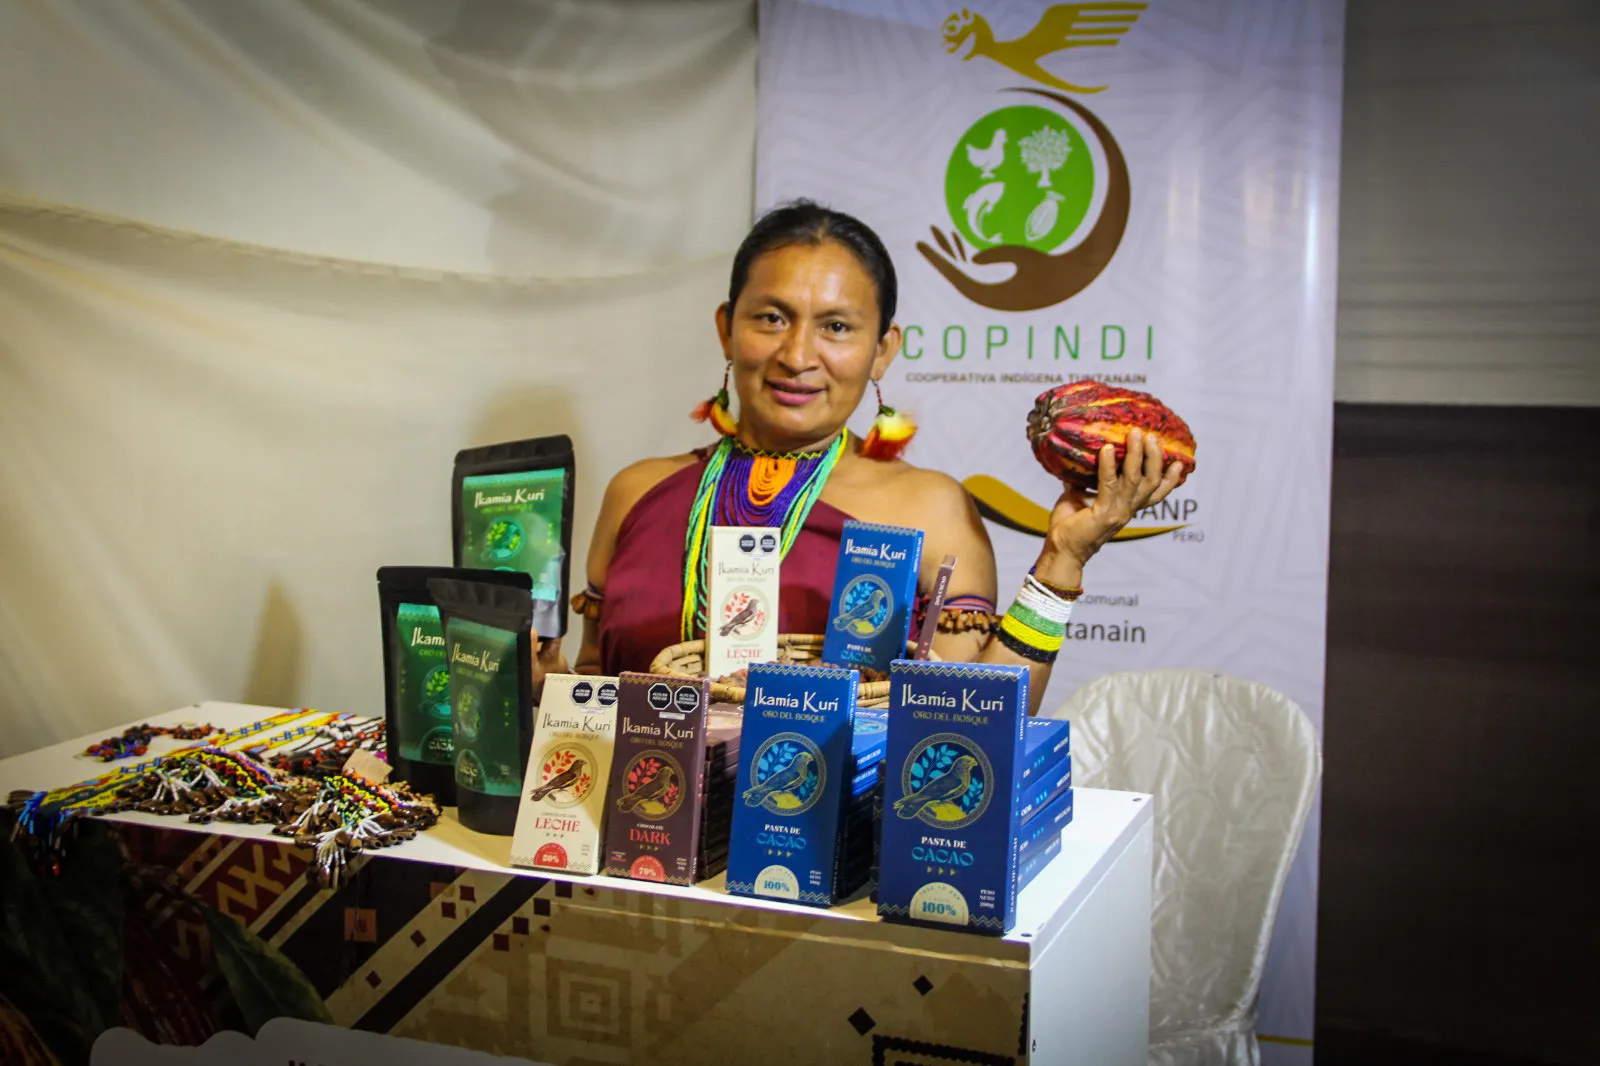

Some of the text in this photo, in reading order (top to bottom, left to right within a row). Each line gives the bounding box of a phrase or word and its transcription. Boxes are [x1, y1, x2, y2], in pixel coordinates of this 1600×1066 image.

[902, 324, 1153, 361] COPINDI
[905, 373, 996, 384] COOPERATIVA
[1132, 498, 1198, 521] ANP
[1065, 620, 1146, 643] tanain
[762, 709, 826, 723] ORO DEL BOSQUE
[913, 710, 989, 726] ORO DEL BOSQUE
[535, 817, 580, 832] LECHE
[764, 823, 801, 835] PASTA DE
[629, 828, 671, 845] DARK
[755, 832, 807, 850] CACAO
[921, 836, 967, 849] PASTA DE
[911, 846, 974, 866] CACAO
[763, 879, 790, 892] 100%
[922, 900, 957, 917] 100%
